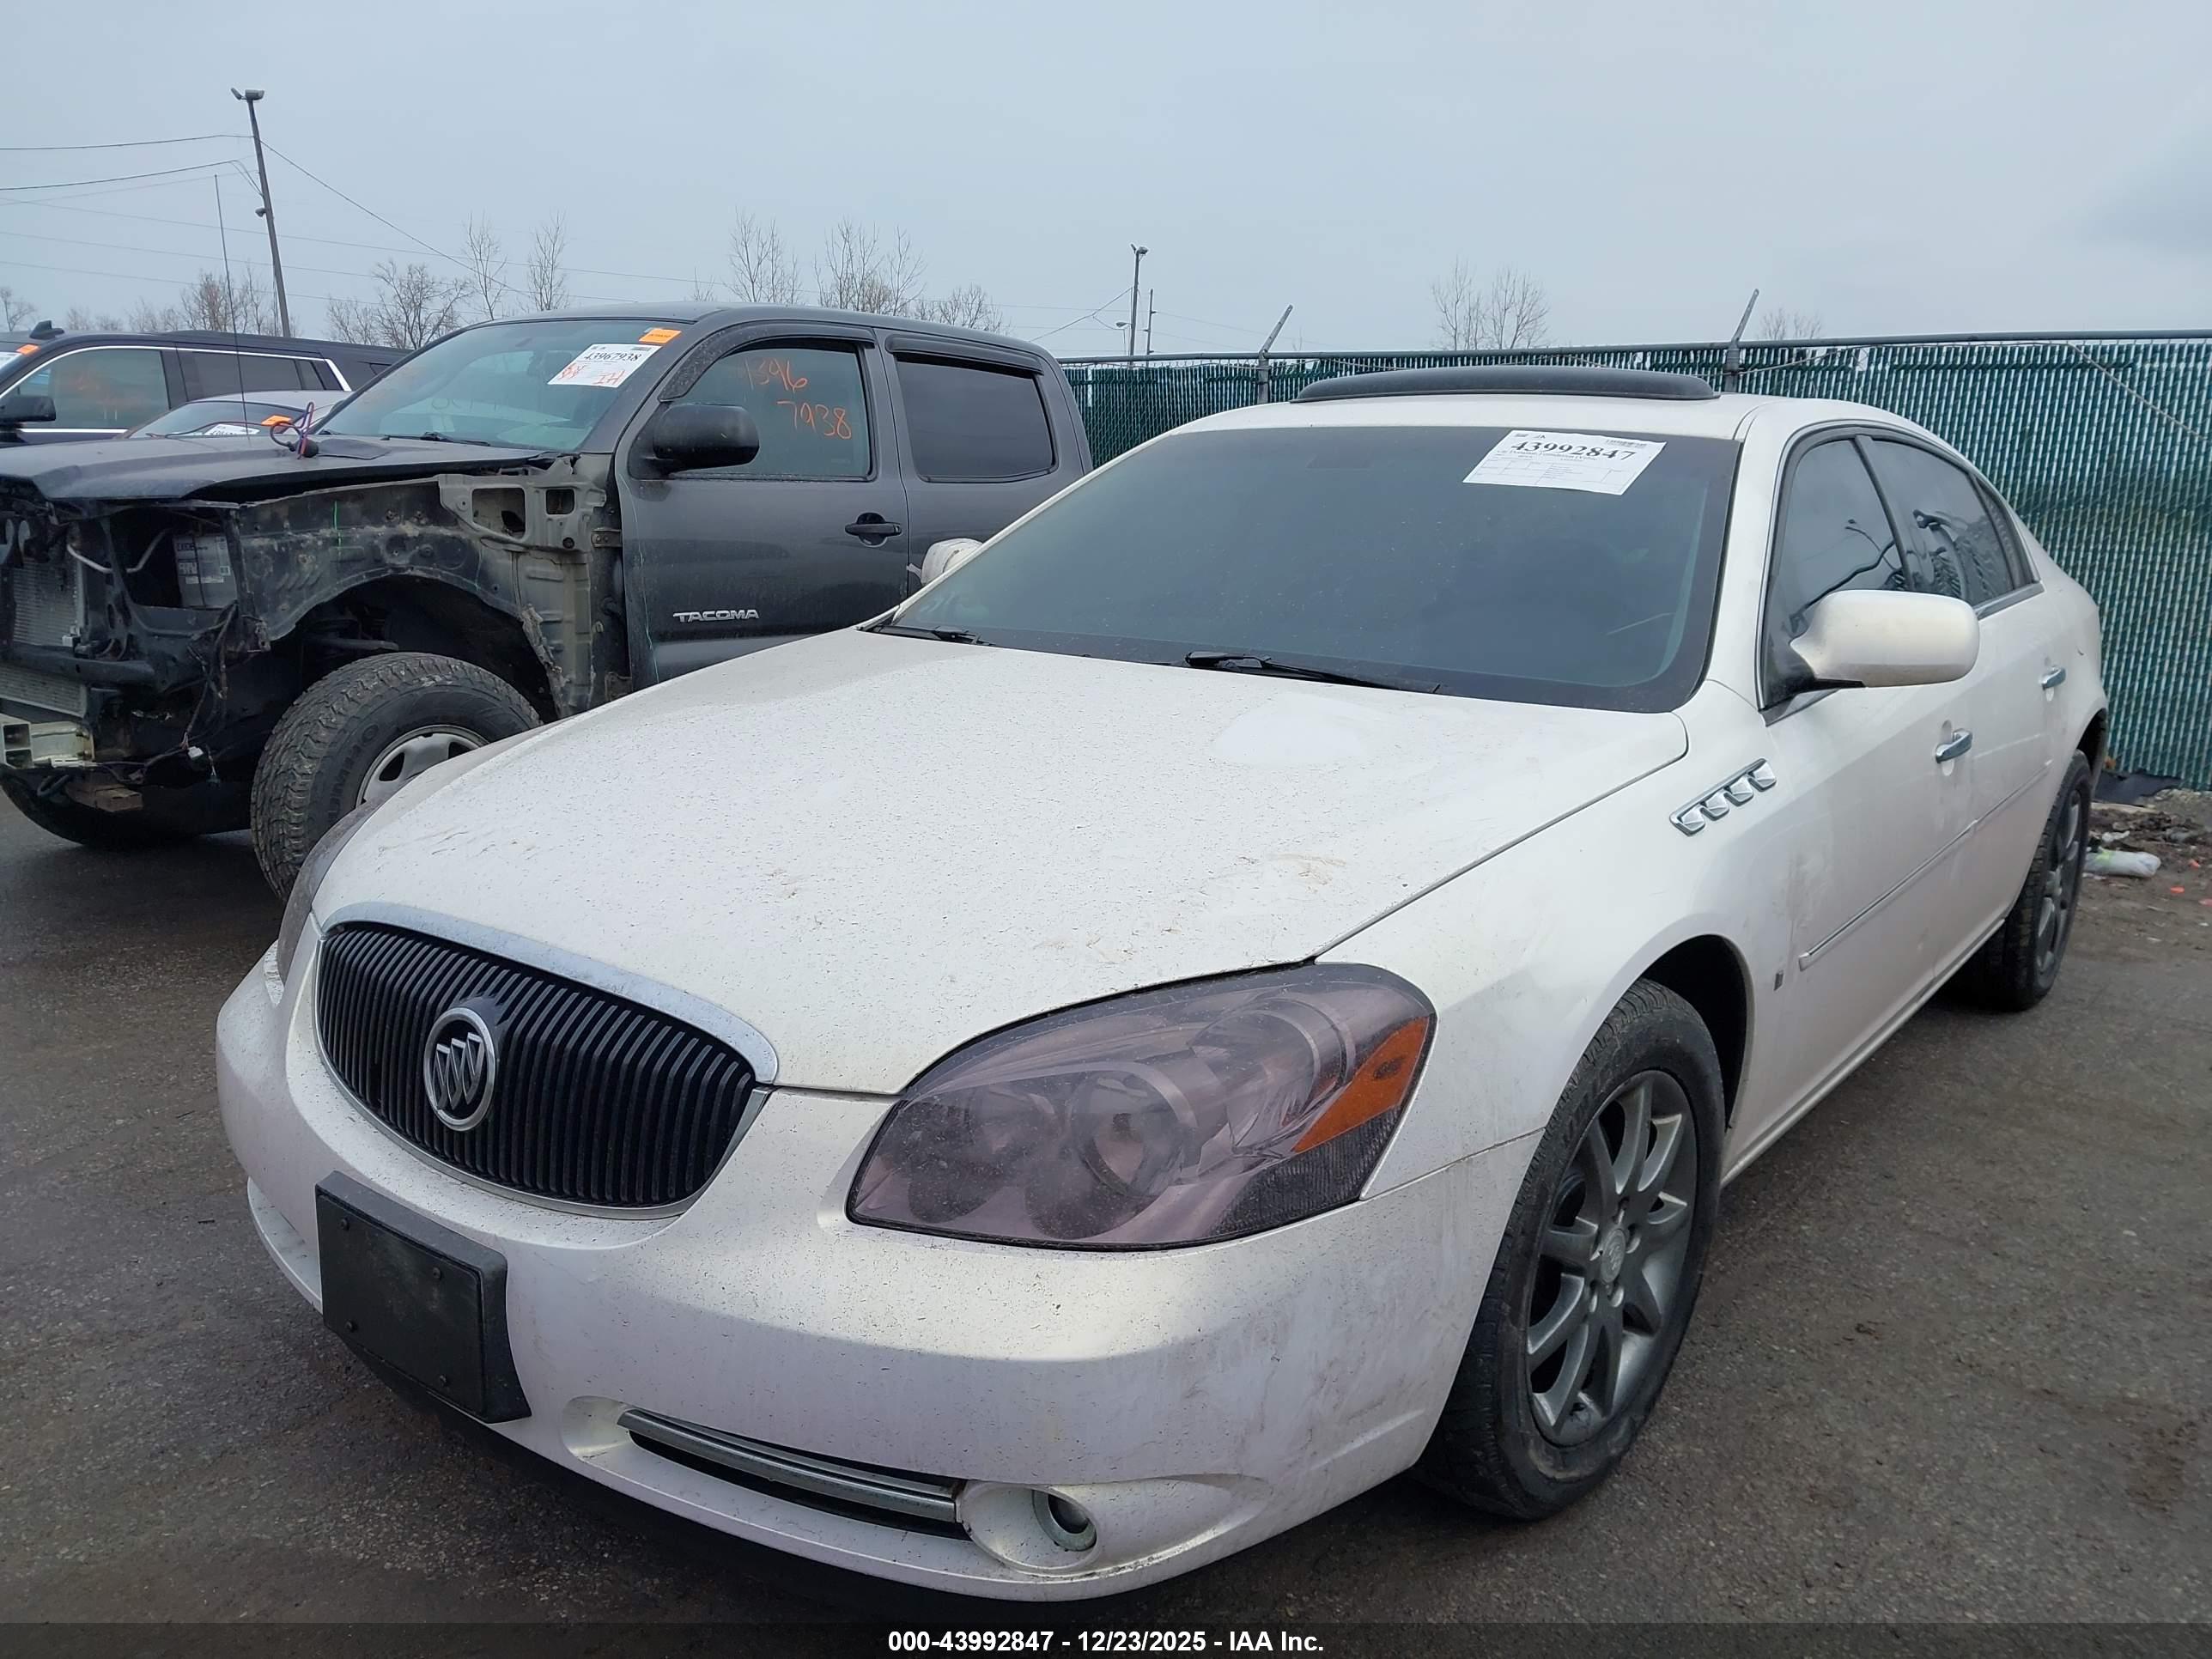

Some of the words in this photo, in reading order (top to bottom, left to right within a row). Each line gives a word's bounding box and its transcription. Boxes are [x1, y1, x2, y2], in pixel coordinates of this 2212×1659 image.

[584, 351, 642, 362] 43967938
[777, 400, 852, 439] 7938
[1511, 441, 1637, 461] 43992847
[672, 609, 760, 623] TACOMA
